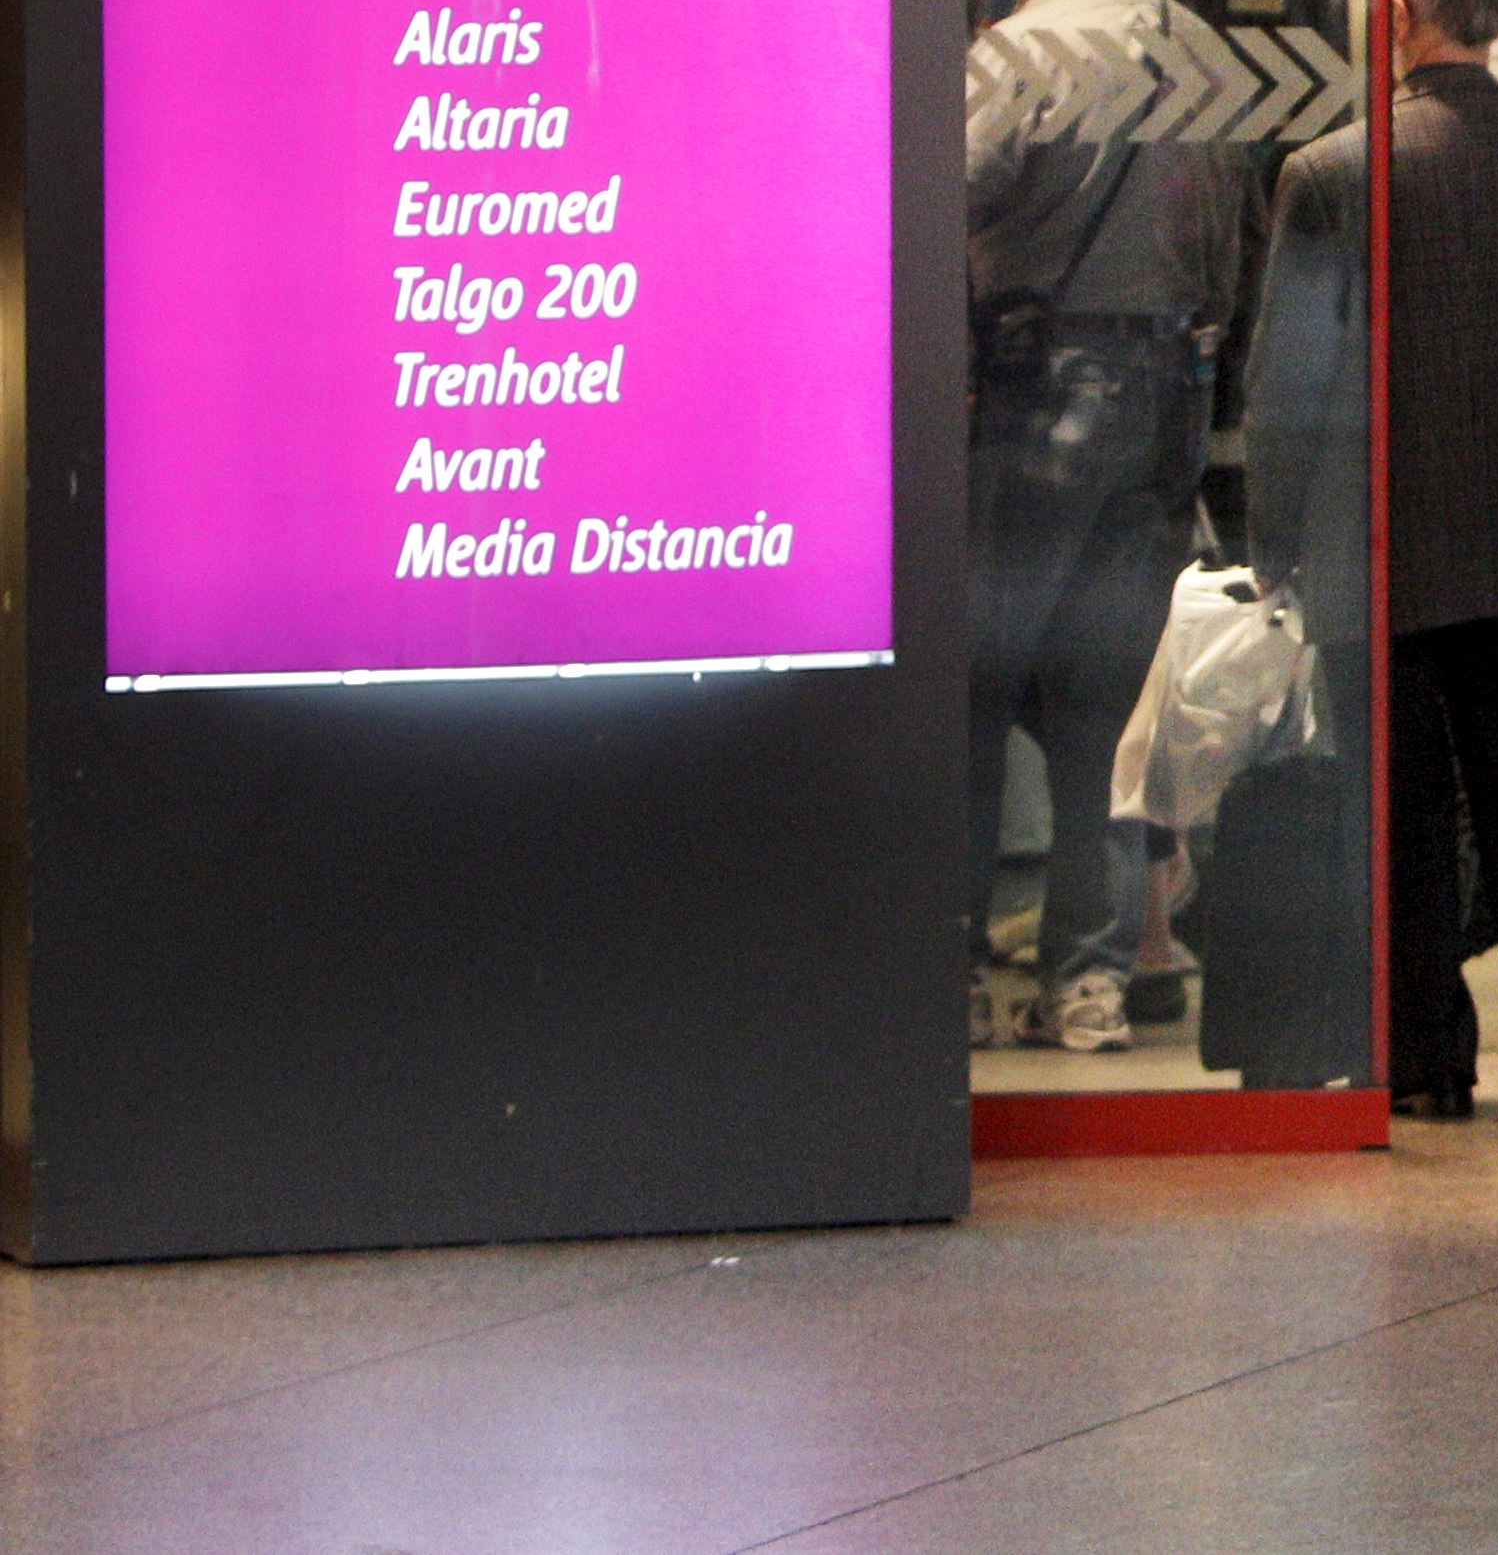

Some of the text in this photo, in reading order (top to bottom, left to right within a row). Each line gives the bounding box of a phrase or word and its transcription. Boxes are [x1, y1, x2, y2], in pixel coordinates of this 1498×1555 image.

[393, 7, 543, 66] Alaris
[393, 92, 570, 151] Altaria
[393, 174, 622, 238] Euromed
[393, 261, 638, 335] Talgo 200
[394, 344, 625, 407] Trenhotel
[395, 436, 546, 494] Avant
[395, 508, 795, 579] Media Distancia
